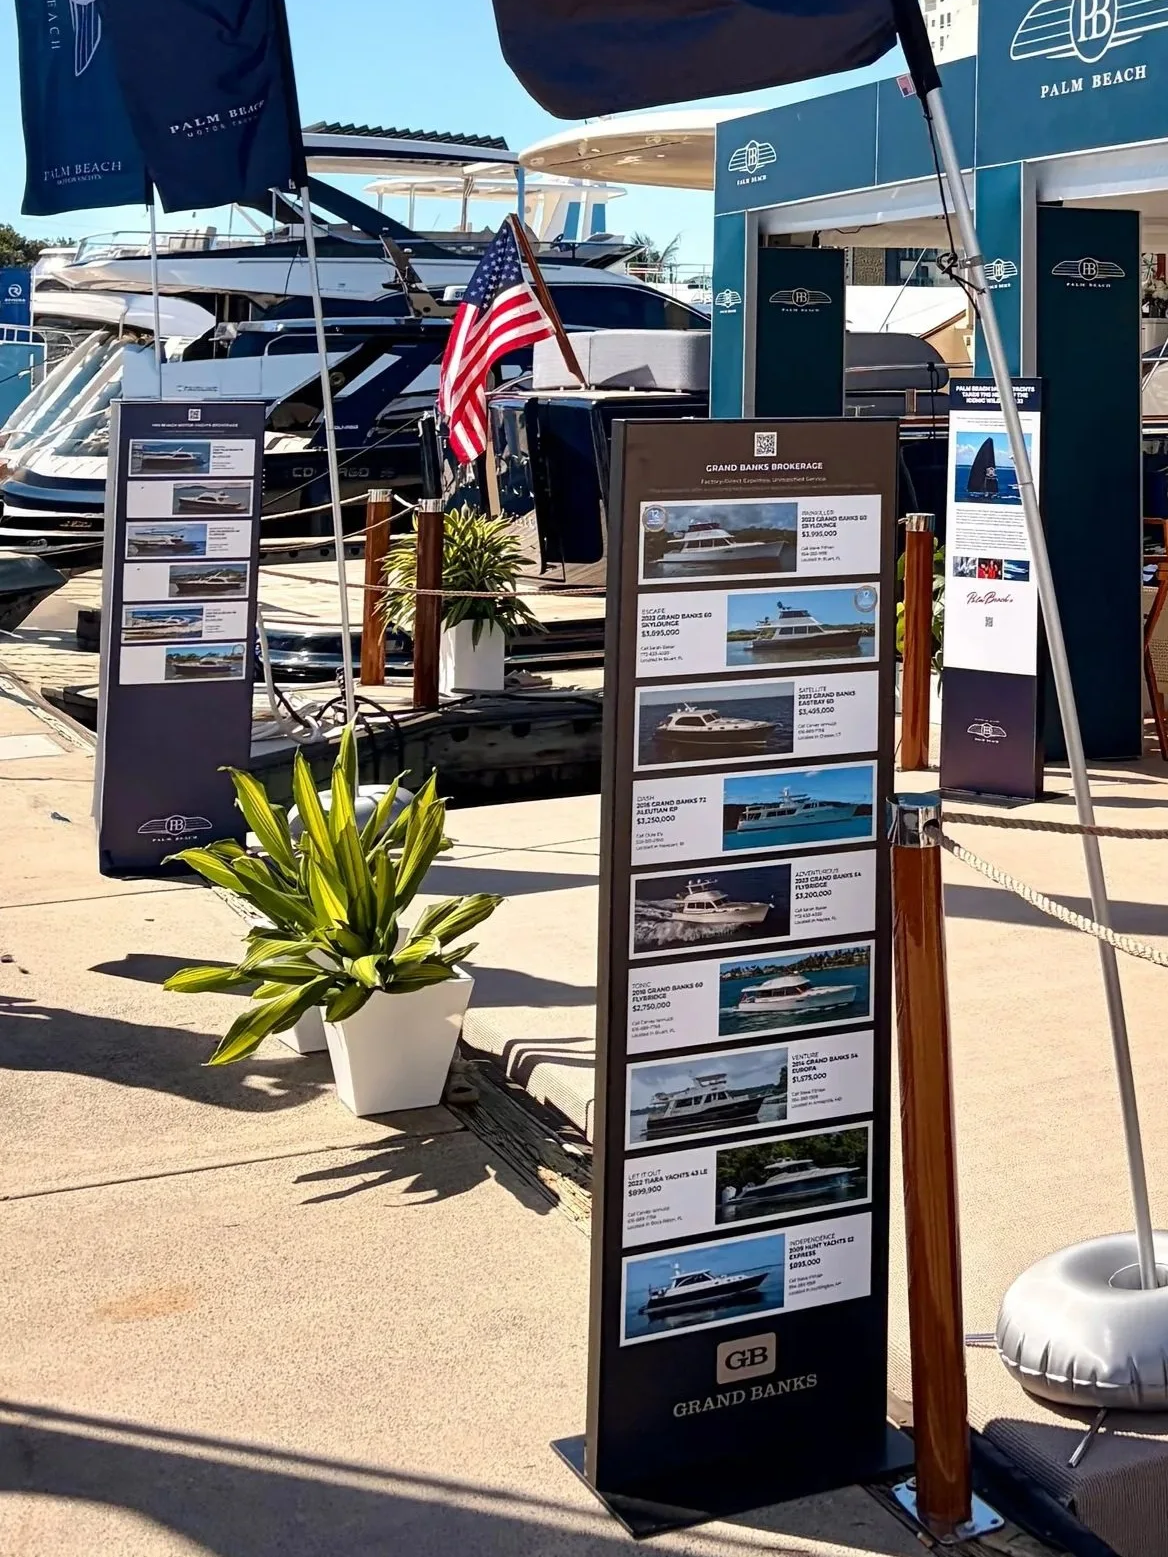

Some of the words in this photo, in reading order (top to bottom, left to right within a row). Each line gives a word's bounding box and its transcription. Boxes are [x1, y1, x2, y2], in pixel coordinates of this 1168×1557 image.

[1040, 77, 1083, 98] PALM
[1092, 64, 1147, 89] BEACH
[169, 113, 220, 134] PALM
[44, 166, 70, 181] PALM
[75, 161, 121, 175] BEACH
[706, 464, 737, 472] GRAND
[740, 463, 769, 472] BANKS
[771, 462, 823, 471] BROKERAGE
[641, 620, 680, 628] SKYLOUNGE
[170, 819, 184, 831] PB
[832, 872, 853, 880] BANKS
[647, 986, 670, 994] GRAND
[672, 983, 694, 991] BANKS
[632, 993, 667, 1003] FLYBRIDGE
[632, 1001, 671, 1012] $2,750,000
[806, 1057, 828, 1065] GRAND
[829, 1054, 850, 1062] BANKS
[792, 1066, 817, 1074] EUROPA
[792, 1072, 827, 1084] $1,575,000
[644, 1176, 664, 1184] TIARA
[664, 1172, 690, 1181] YACHTS
[648, 1169, 661, 1177] OUT
[628, 1185, 662, 1197] $899,900
[805, 1242, 822, 1250] HUNT
[822, 1238, 846, 1247] YACHTS
[789, 1250, 816, 1260] EXPRESS
[725, 1346, 768, 1370] GB
[673, 1389, 746, 1418] GRAND
[750, 1373, 818, 1401] BANKS
